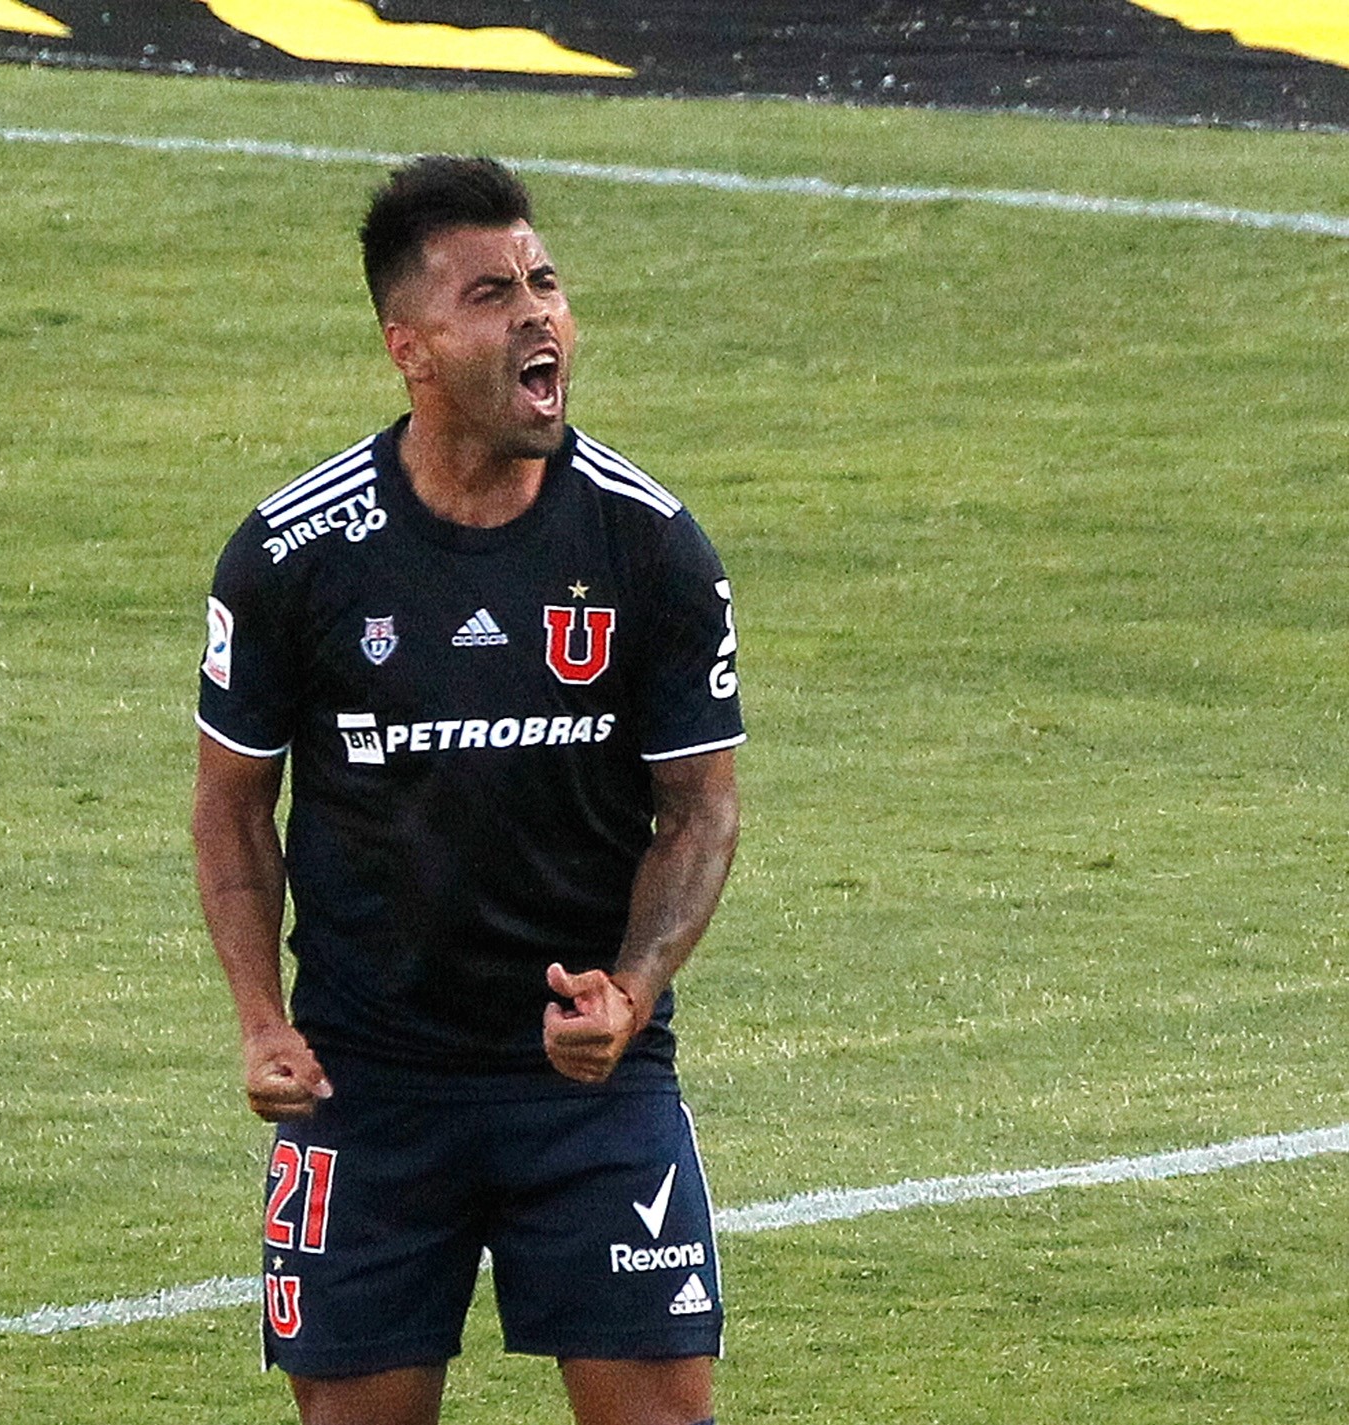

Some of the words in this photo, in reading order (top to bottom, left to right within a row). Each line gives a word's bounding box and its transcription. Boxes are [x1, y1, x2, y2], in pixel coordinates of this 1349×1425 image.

[261, 485, 377, 565] DIRECTV
[344, 507, 388, 542] GO
[544, 605, 616, 684] U
[386, 713, 616, 753] PETROBRAS
[264, 1139, 338, 1254] 21
[610, 1242, 705, 1273] Rexona
[265, 1274, 302, 1339] U
